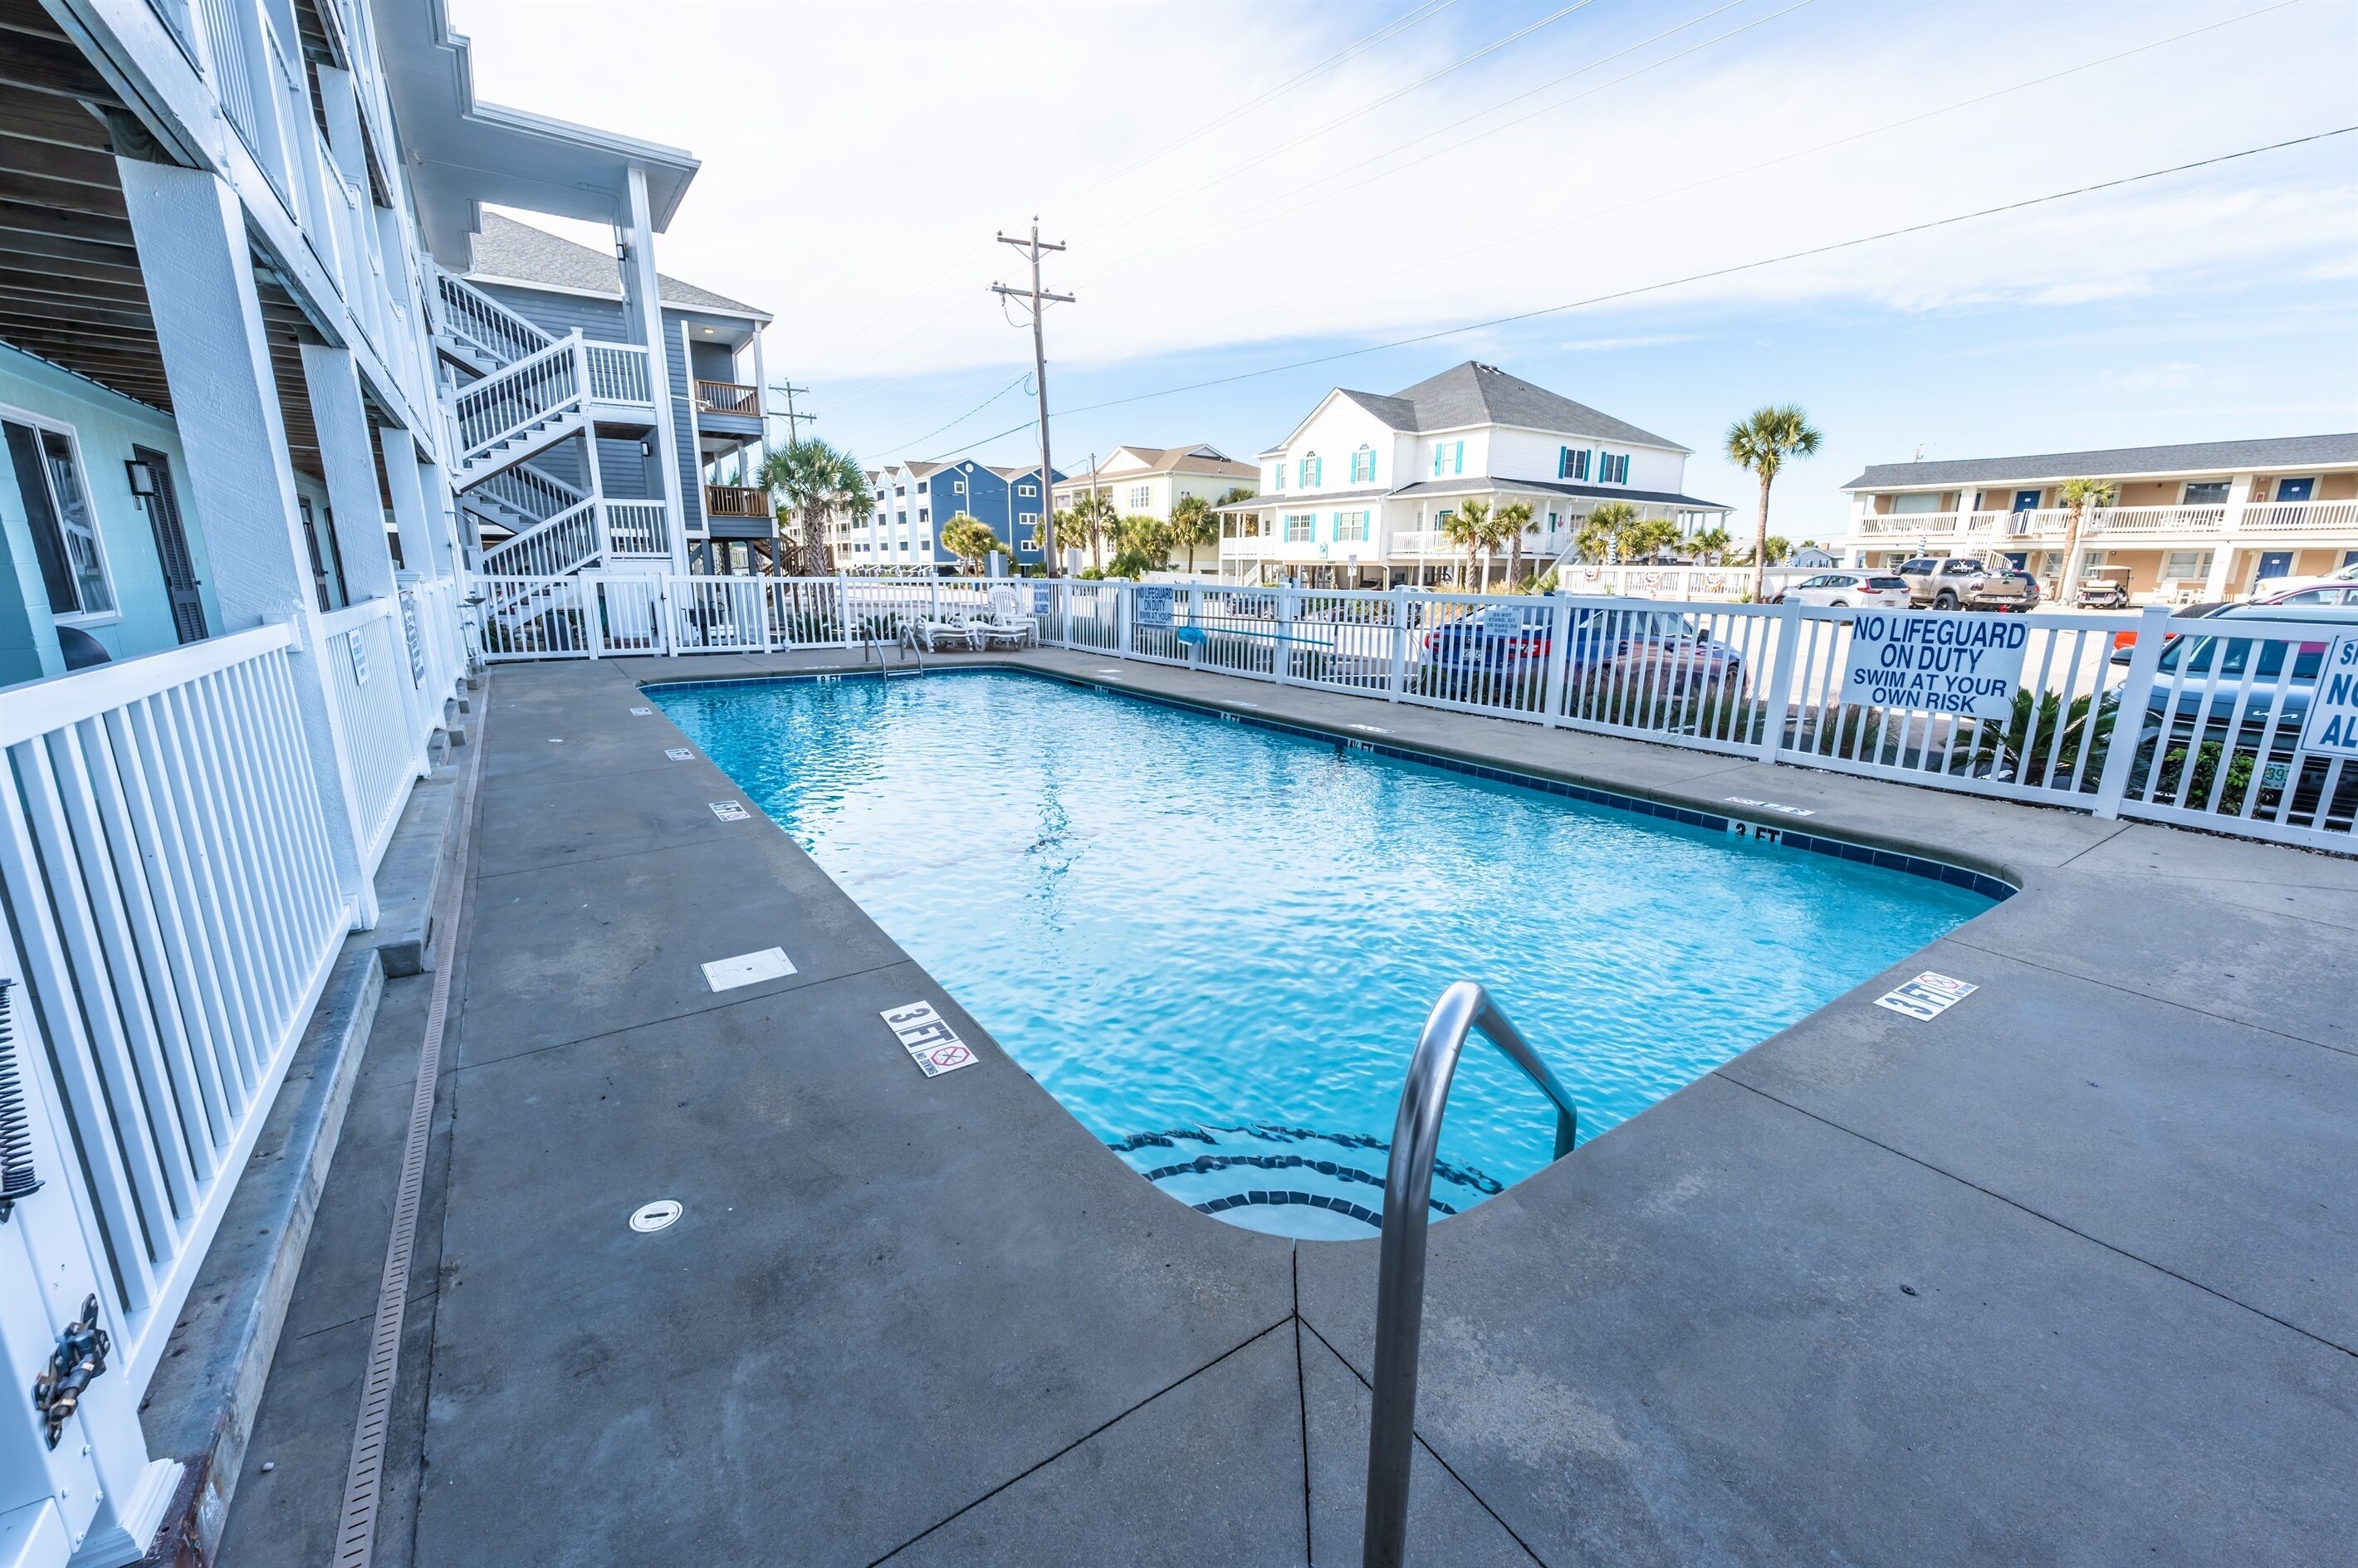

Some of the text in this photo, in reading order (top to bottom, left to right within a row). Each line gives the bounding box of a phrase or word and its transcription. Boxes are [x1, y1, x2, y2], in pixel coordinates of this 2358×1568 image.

[1137, 587, 1173, 599] NO LIFEGUARD
[1144, 599, 1166, 612] ON DUTY
[1139, 611, 1172, 621] SWIM AT YOUR
[1853, 616, 2027, 649] NO LIFEGUARD
[1881, 643, 1984, 674] ON DUTY
[1853, 668, 2008, 697] SWIM AT YOUR
[1871, 687, 1978, 713] OWN RISK
[1734, 823, 1781, 843] 3 FT
[1885, 983, 1955, 1015] 3 FT
[888, 1008, 956, 1048] 3 FT
[920, 1058, 939, 1075] DIVING
